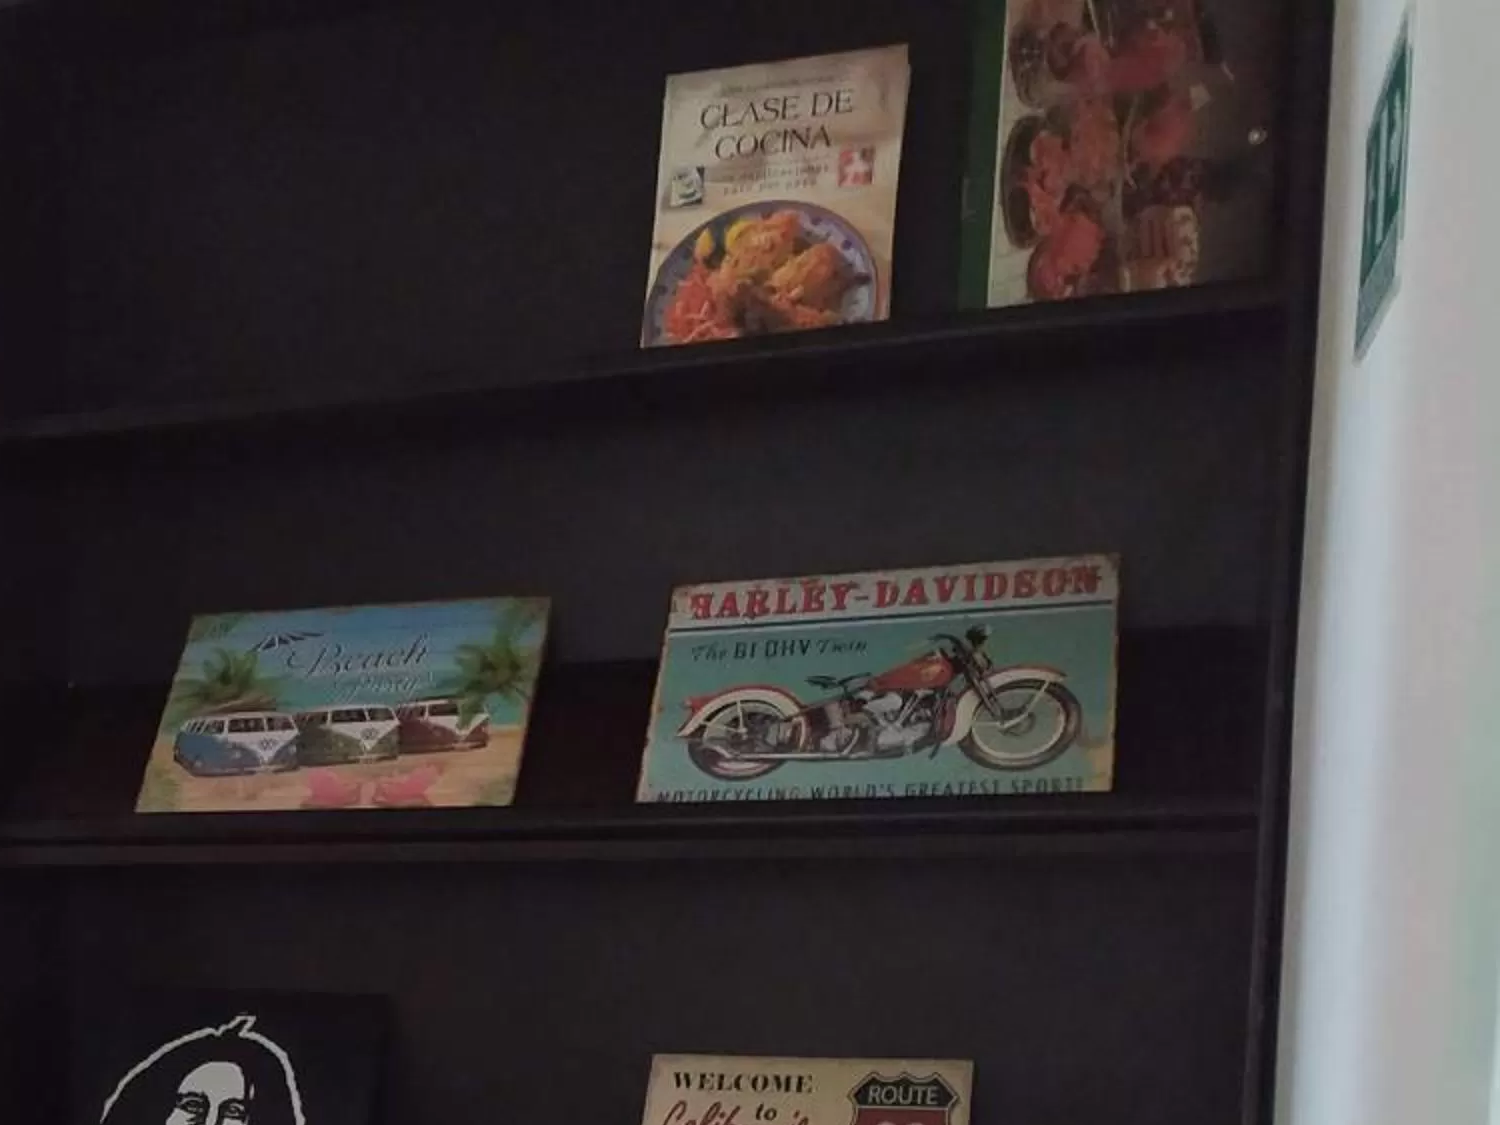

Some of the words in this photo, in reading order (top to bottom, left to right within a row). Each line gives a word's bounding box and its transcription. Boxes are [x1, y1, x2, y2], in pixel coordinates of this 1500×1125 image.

[700, 95, 802, 131] CLASE
[811, 88, 854, 118] DE
[715, 125, 832, 161] COCINA
[765, 639, 811, 660] OHV
[673, 1071, 814, 1094] WELCOME
[867, 1084, 939, 1106] ROUTE
[755, 1103, 777, 1122] to
